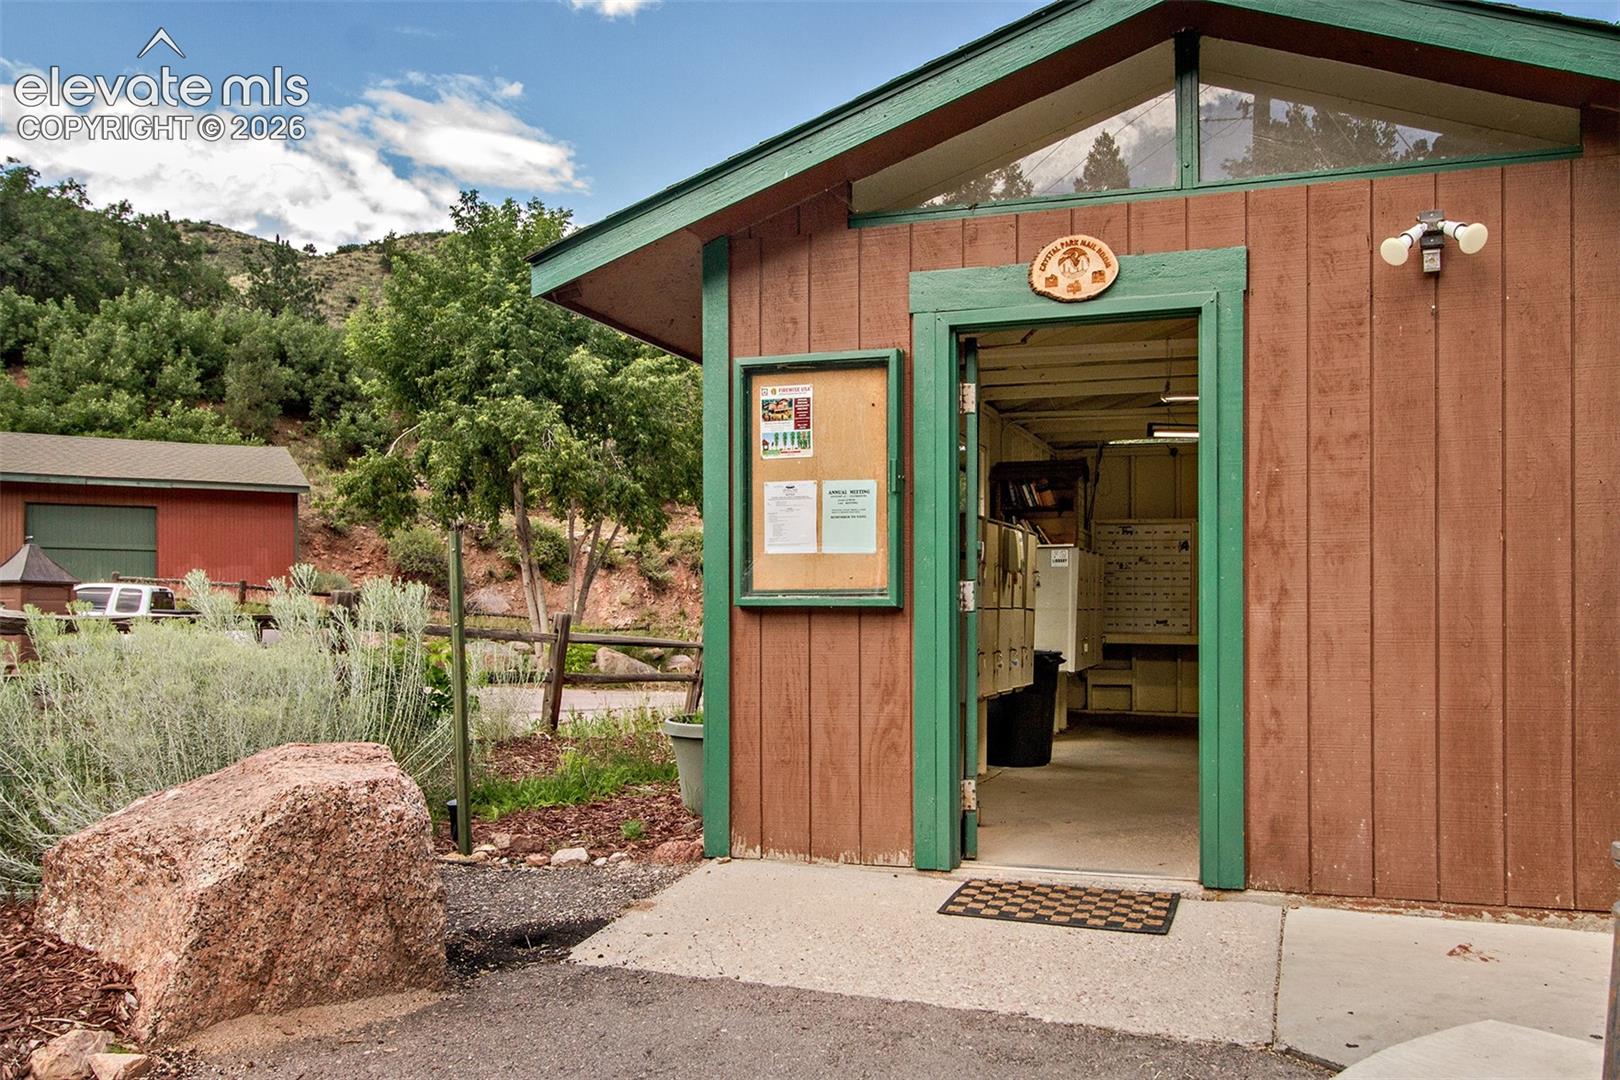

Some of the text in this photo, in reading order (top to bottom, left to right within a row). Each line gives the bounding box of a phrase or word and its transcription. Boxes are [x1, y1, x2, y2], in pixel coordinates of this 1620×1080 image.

[1039, 245, 1061, 272] CRYSTAL
[1060, 239, 1080, 249] PARK
[1080, 239, 1097, 251] MAIL
